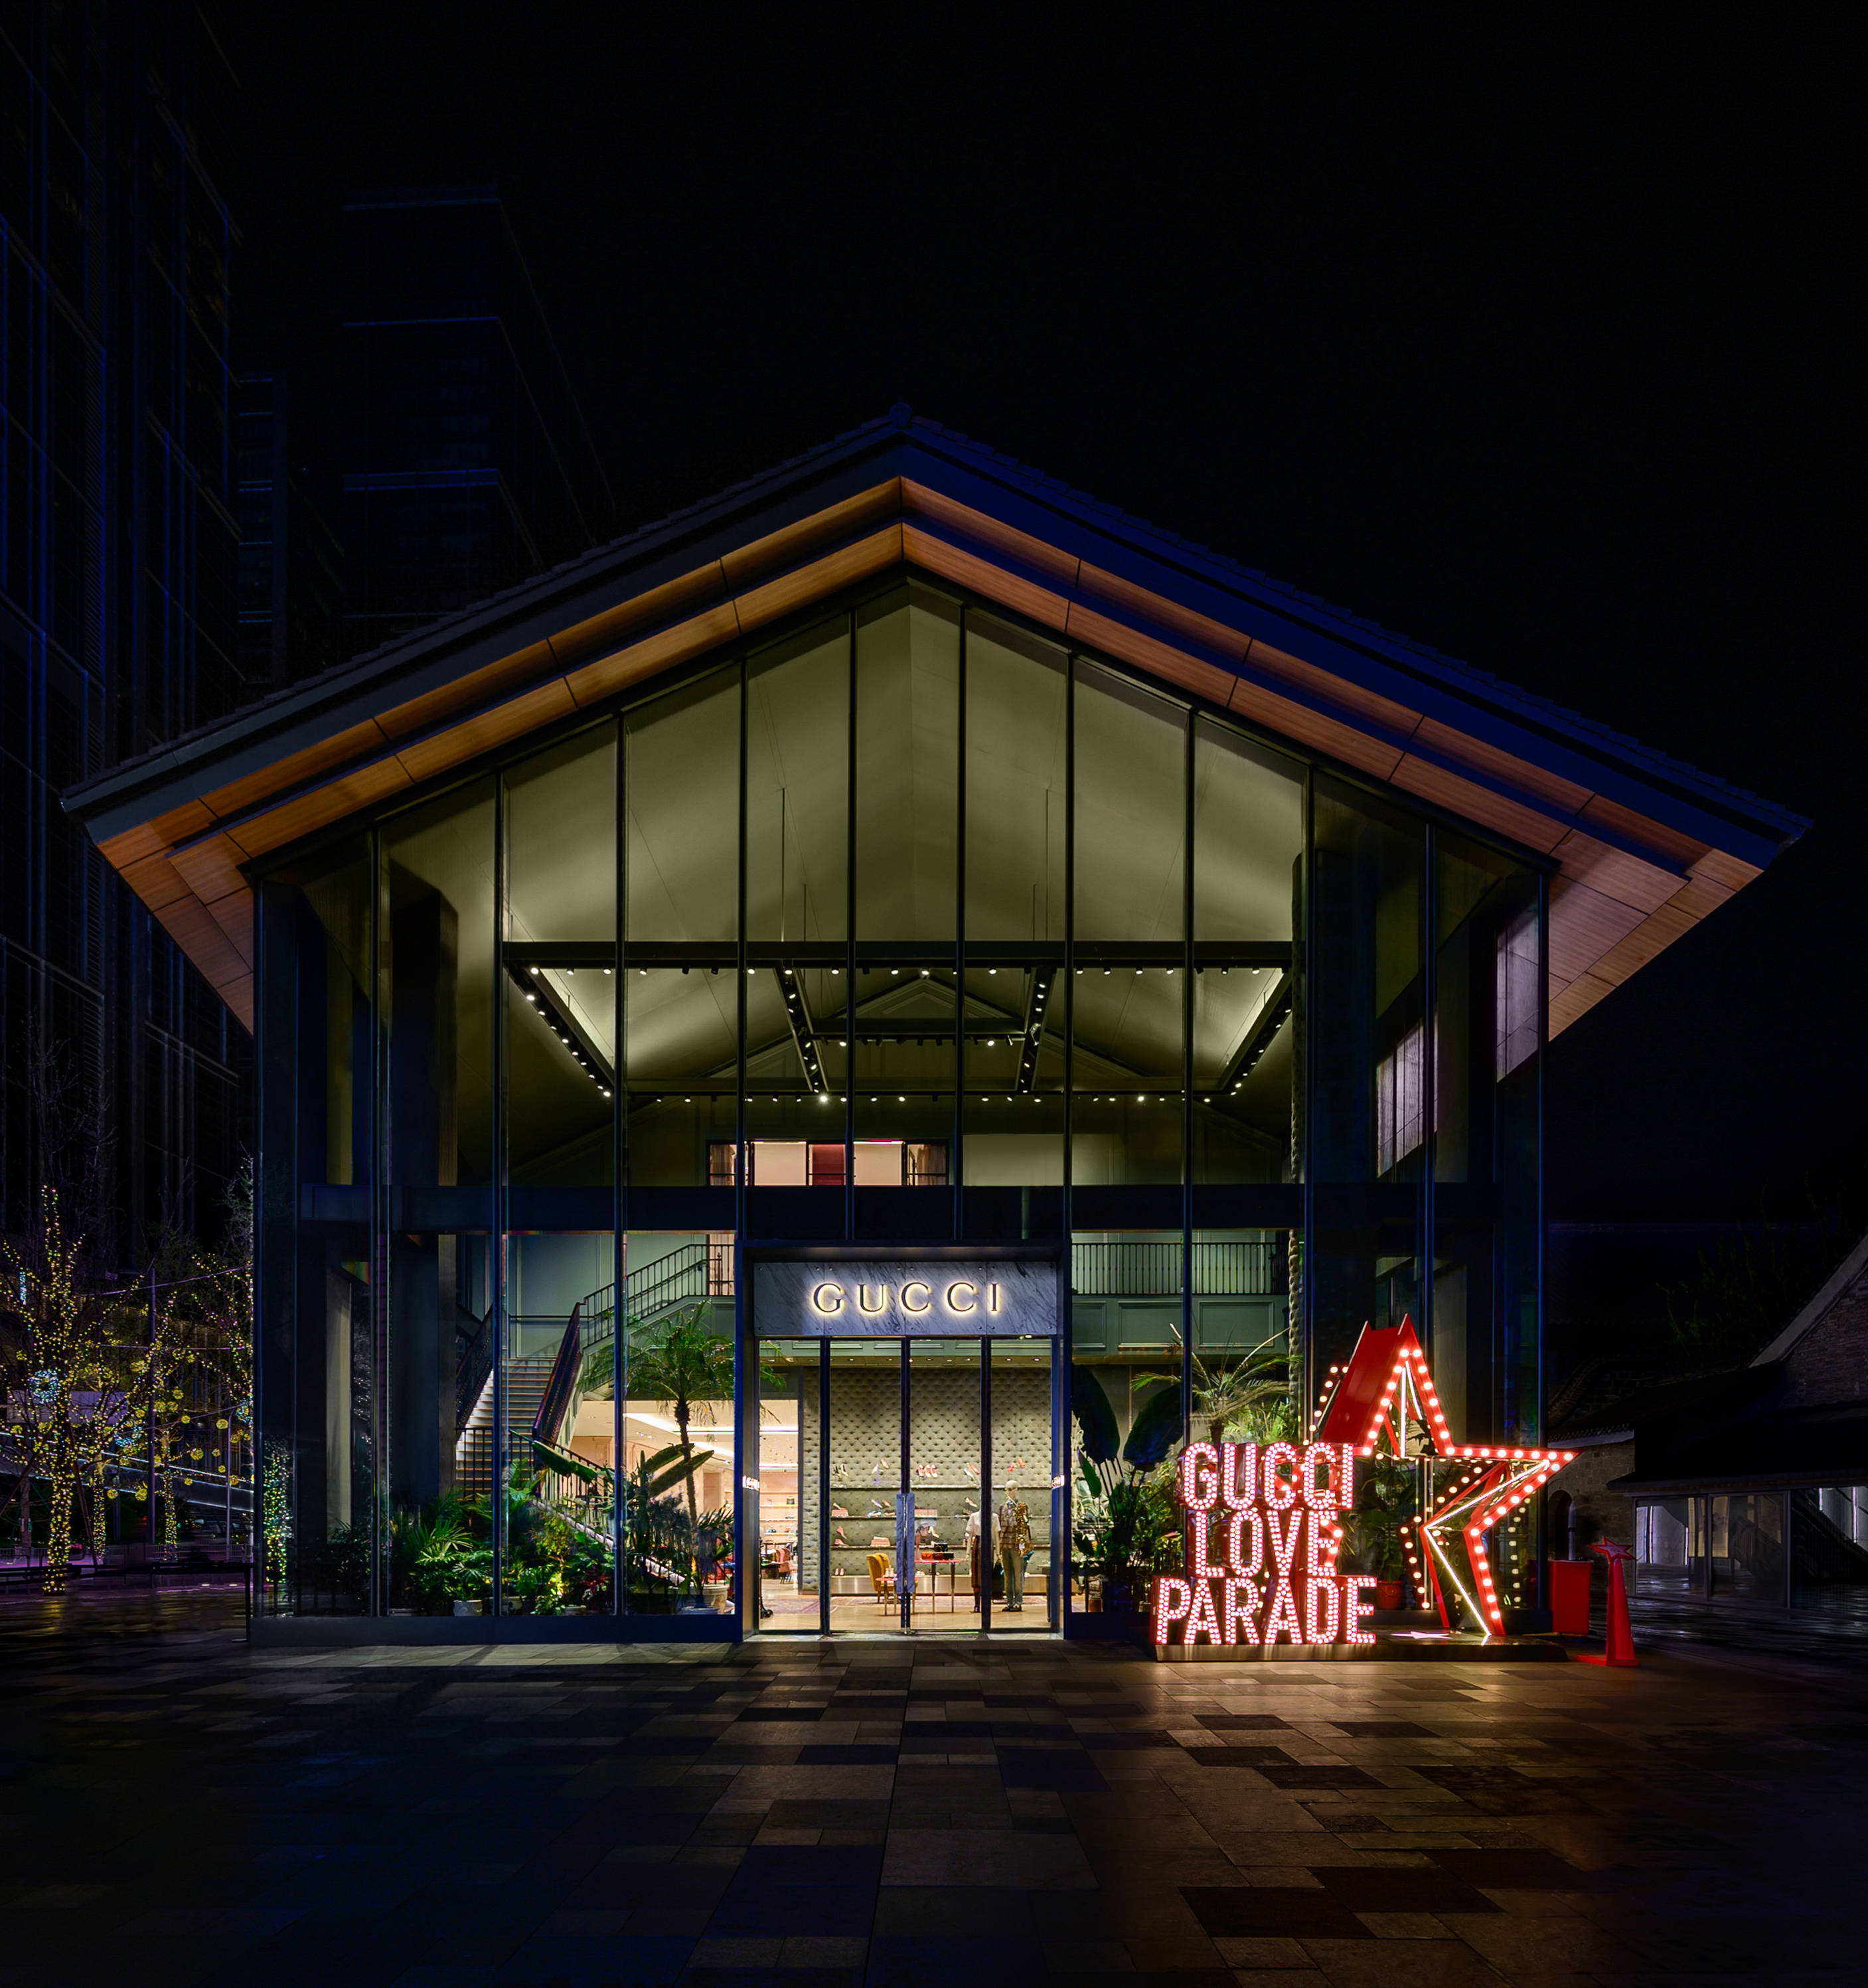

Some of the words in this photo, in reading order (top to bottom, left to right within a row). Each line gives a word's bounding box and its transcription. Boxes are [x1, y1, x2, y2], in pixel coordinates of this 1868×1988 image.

[813, 1282, 1000, 1313] GUCCI
[1184, 1442, 1354, 1509] GUCCI
[1195, 1509, 1337, 1577] LOVE
[1156, 1577, 1377, 1644] PARADE
